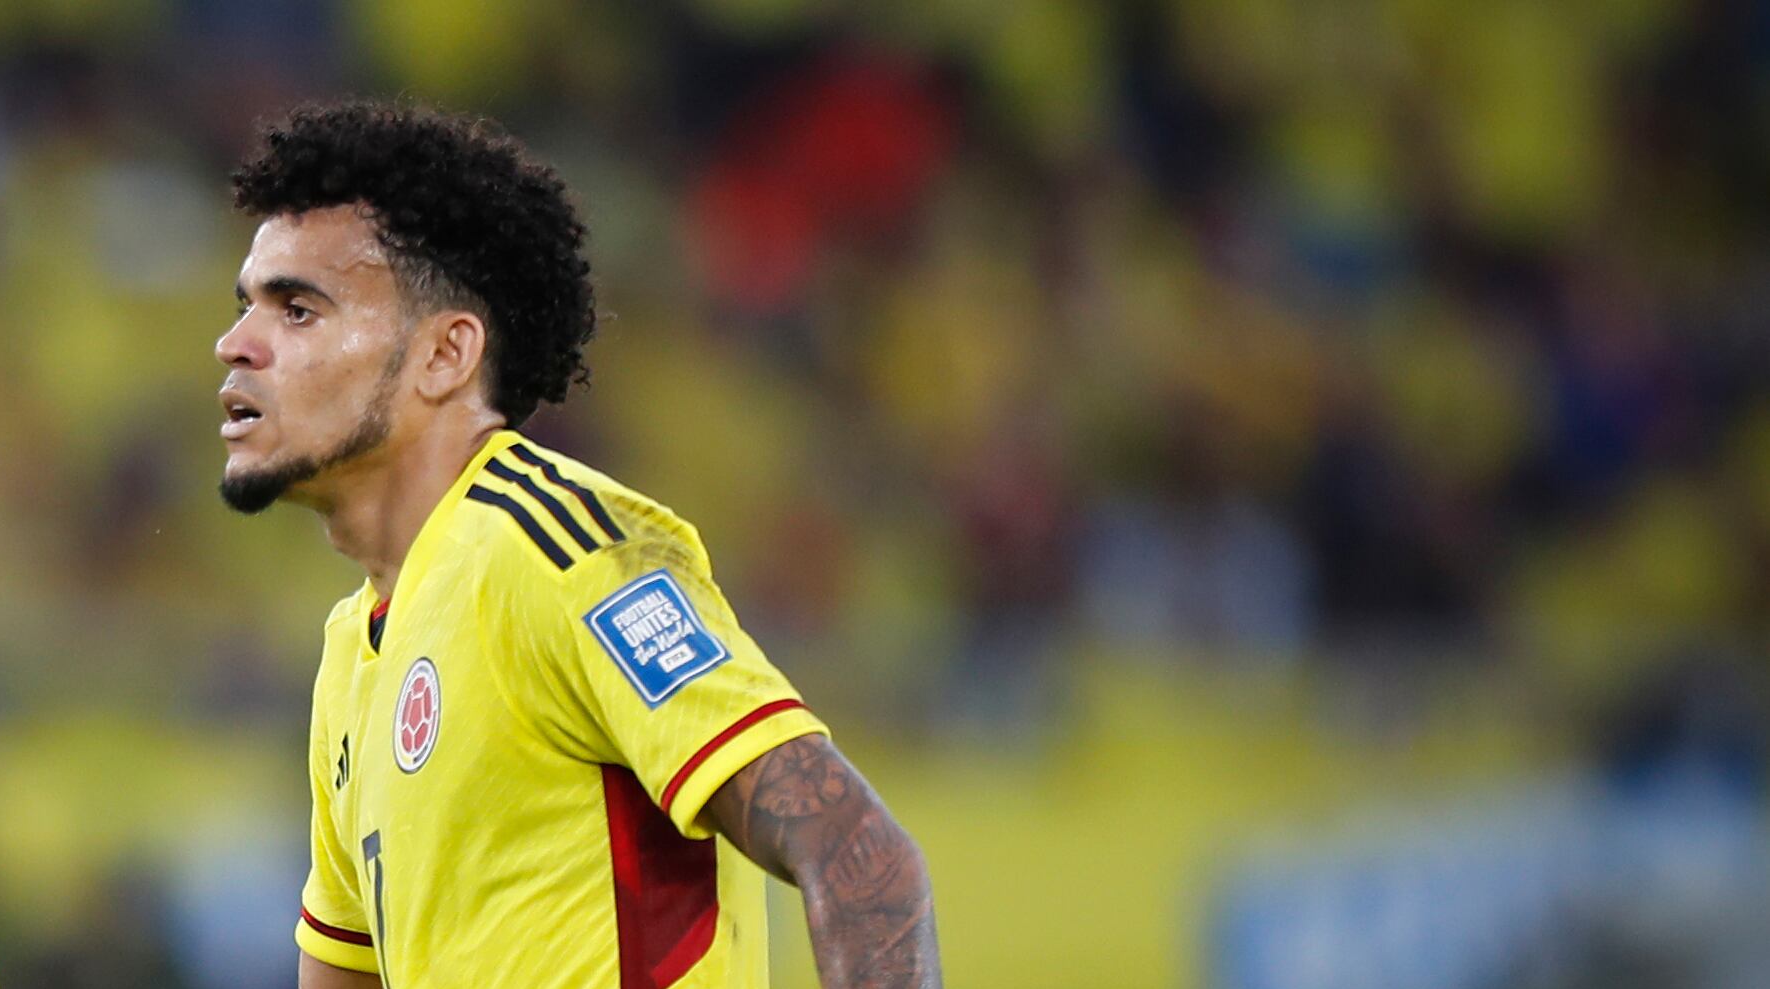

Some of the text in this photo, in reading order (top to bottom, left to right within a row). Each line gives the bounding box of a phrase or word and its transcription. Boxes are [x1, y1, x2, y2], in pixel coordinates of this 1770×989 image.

[612, 589, 669, 631] FOOTBALL
[622, 601, 681, 647] UNITES
[653, 618, 696, 651] World
